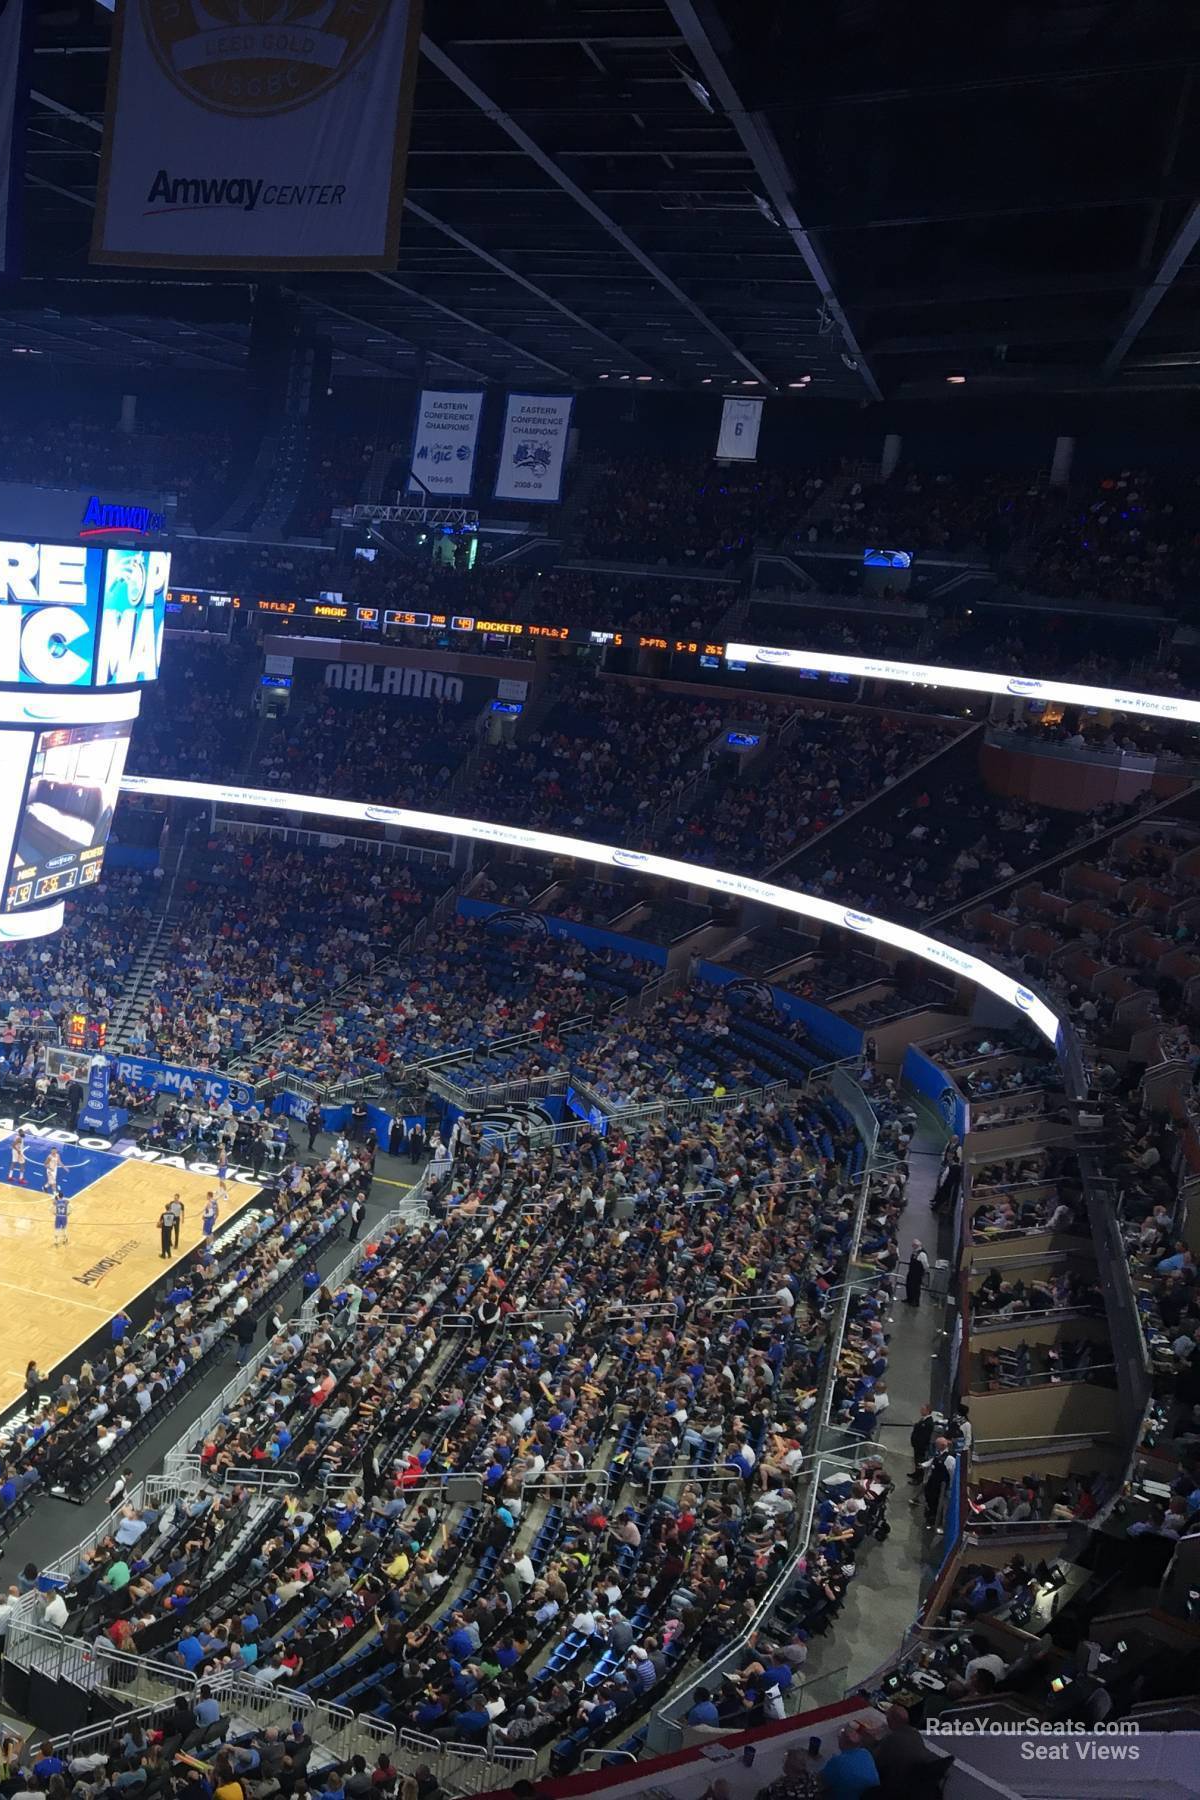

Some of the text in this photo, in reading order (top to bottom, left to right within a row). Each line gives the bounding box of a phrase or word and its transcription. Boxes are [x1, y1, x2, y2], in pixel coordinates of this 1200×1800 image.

[148, 169, 347, 211] Amway CENTER
[432, 402, 469, 411] EASTERN
[520, 406, 558, 415] EASTERN
[423, 411, 475, 421] CONFERENCE
[511, 416, 564, 426] CONFERENCE
[425, 422, 471, 432] CHAMPIONS
[512, 426, 559, 436] CHAMPIONS
[734, 422, 744, 436] 6
[83, 495, 150, 533] Amway
[288, 603, 296, 613] 2
[314, 606, 348, 617] MAGIC
[360, 609, 374, 621] 42
[394, 613, 416, 624] 2:56
[458, 618, 472, 629] 49
[476, 621, 523, 634] ROCKETS
[560, 627, 569, 639] 2
[325, 663, 464, 703] ORLANDO
[164, 1071, 223, 1099] MAIC
[71, 1256, 122, 1286] Amway
